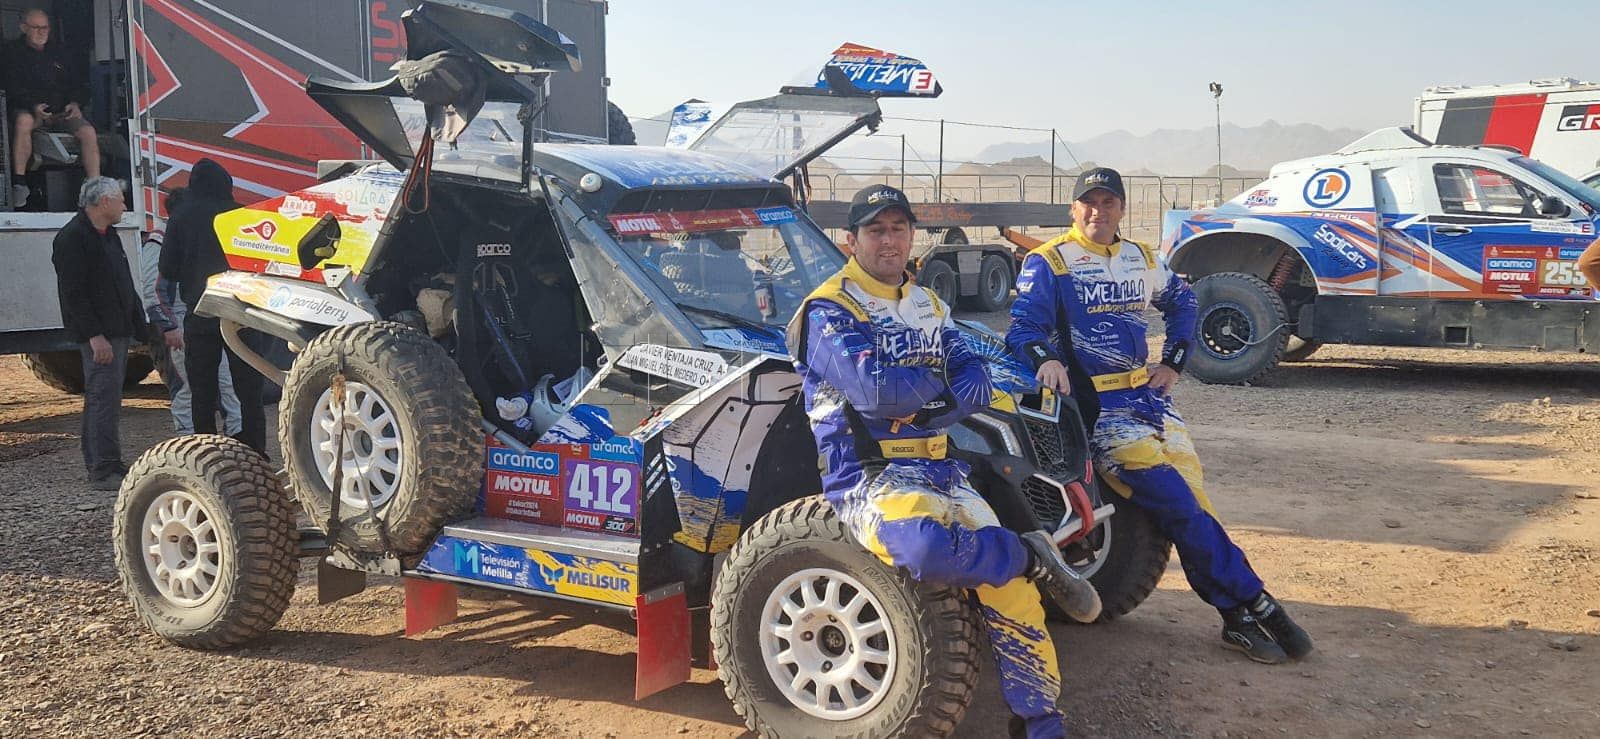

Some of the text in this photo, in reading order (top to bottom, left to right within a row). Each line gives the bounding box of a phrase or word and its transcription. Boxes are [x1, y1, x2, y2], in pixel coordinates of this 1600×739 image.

[1313, 179, 1333, 200] L
[761, 210, 793, 221] aramco
[616, 218, 661, 232] MOTUL
[477, 244, 511, 257] sparco
[1489, 260, 1533, 268] aramco
[1489, 272, 1530, 281] MOTUL
[694, 358, 714, 373] CRUZ
[493, 452, 555, 471] aramco
[494, 475, 552, 496] MOTUL
[568, 463, 632, 514] 412
[566, 512, 601, 526] MOTUL
[480, 552, 521, 569] Televisión
[481, 565, 513, 579] Melilla
[567, 571, 630, 593] MELISUR
